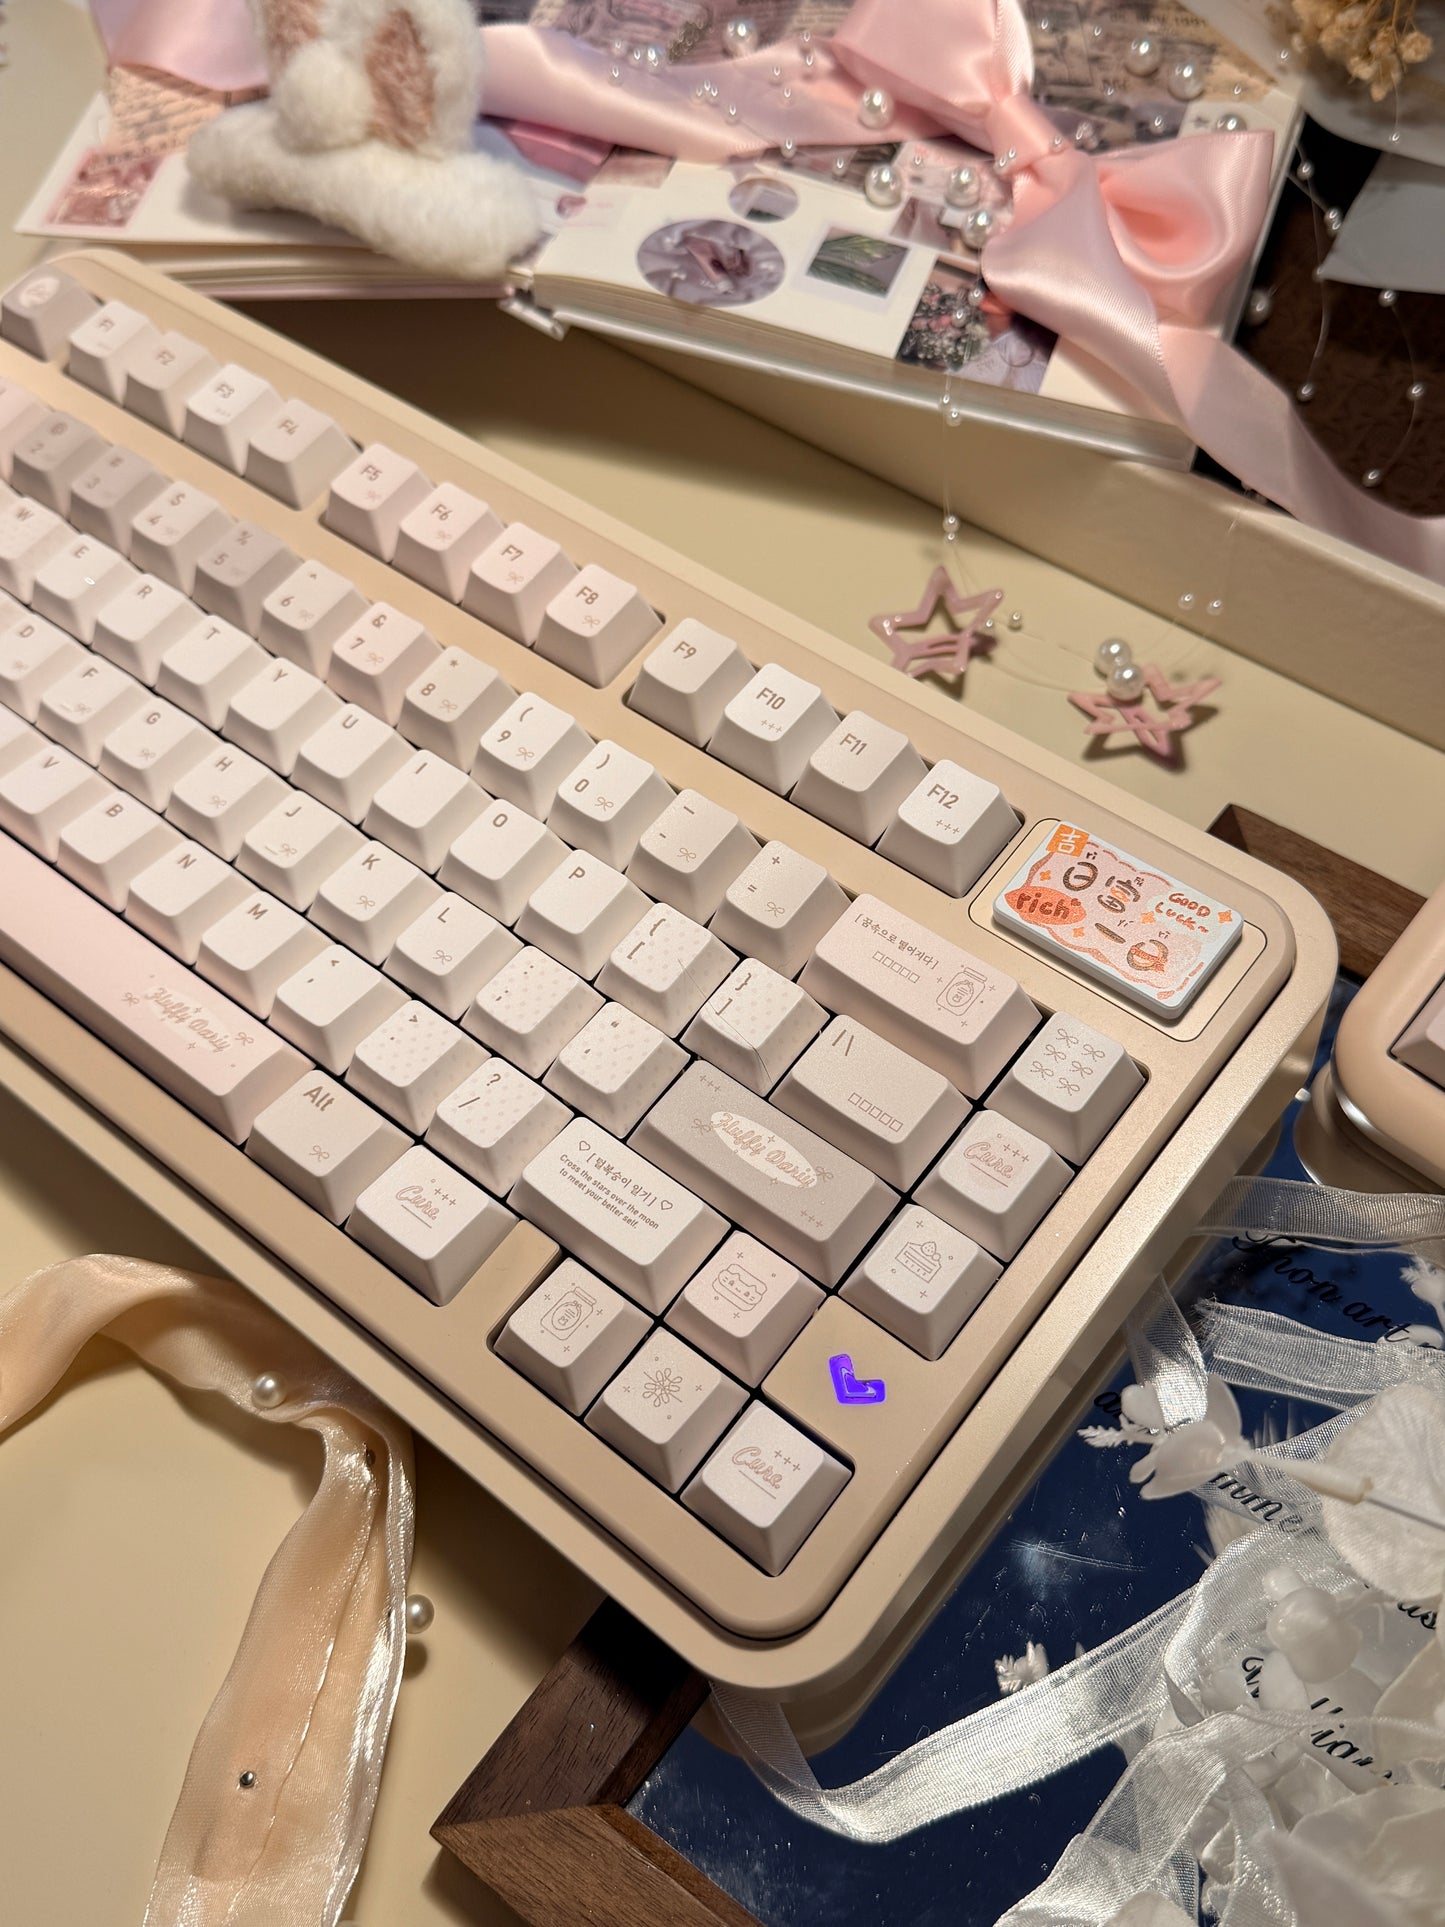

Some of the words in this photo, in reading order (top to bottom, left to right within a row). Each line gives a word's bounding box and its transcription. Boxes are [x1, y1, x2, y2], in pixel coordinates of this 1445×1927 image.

[155, 350, 177, 366] F2
[214, 383, 236, 399] F3
[277, 418, 300, 436] F4
[360, 463, 383, 482] F5
[15, 507, 33, 522] W
[431, 503, 453, 522] F6
[73, 545, 91, 559] E
[213, 553, 229, 566] 5
[500, 544, 524, 562] F7
[136, 584, 154, 599] R
[575, 585, 600, 606] F8
[280, 595, 295, 608] 6
[371, 613, 388, 630] &
[18, 625, 35, 639] D
[205, 627, 221, 641] T
[349, 636, 366, 651] 7
[672, 640, 697, 660] F9
[81, 666, 99, 680] F
[273, 668, 289, 684] Y
[420, 682, 437, 697] 8
[755, 687, 786, 710] F10
[146, 711, 162, 726] G
[341, 714, 360, 730] U
[496, 729, 512, 743] 9
[839, 733, 868, 756] F11
[43, 756, 61, 770] V
[214, 756, 234, 773] H
[926, 782, 961, 811] F12
[105, 803, 124, 818] B
[284, 805, 303, 818] J
[1058, 829, 1082, 854] 吉
[177, 853, 197, 870] N
[360, 852, 382, 871] K
[567, 865, 586, 880] P
[247, 902, 269, 921] M
[1015, 892, 1072, 921] rich
[437, 906, 451, 924] L
[485, 1072, 503, 1088] ?
[302, 1084, 336, 1113] Alt
[560, 1154, 580, 1172] Cross
[581, 1170, 593, 1182] the
[592, 1178, 611, 1195] stars
[611, 1194, 627, 1206] over
[627, 1204, 639, 1215] the
[639, 1214, 659, 1229] moon
[560, 1168, 568, 1177] to
[568, 1174, 585, 1190] meet
[585, 1188, 602, 1201] your
[602, 1199, 623, 1217] better
[622, 1215, 640, 1229] self.
[1341, 1300, 1413, 1344] art
